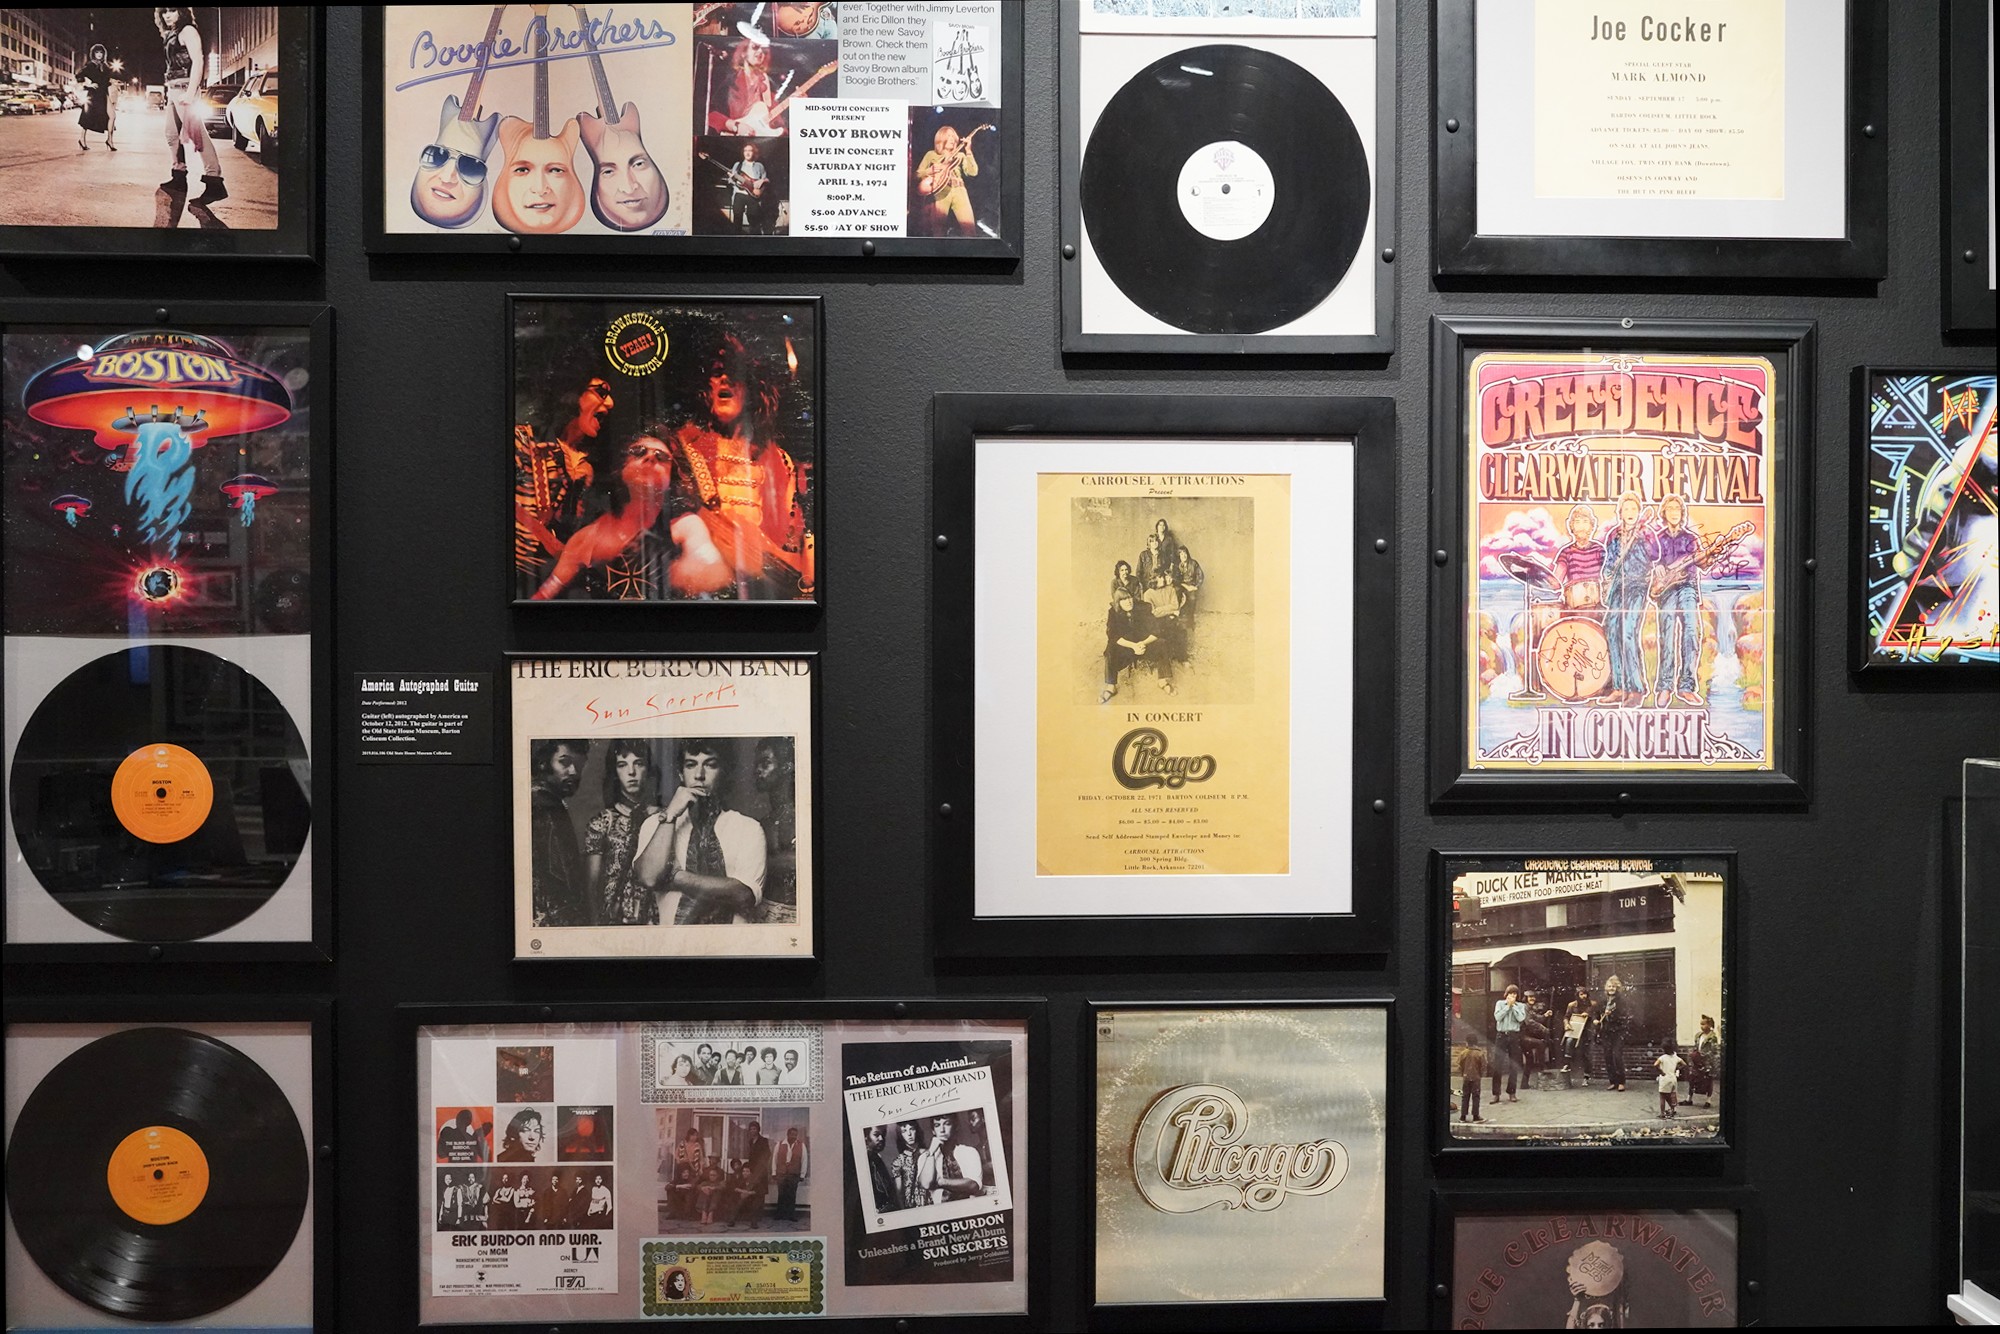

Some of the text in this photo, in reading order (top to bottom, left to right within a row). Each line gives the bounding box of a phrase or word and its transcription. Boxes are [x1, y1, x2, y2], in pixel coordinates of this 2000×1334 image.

[843, 3, 994, 15] ever. Together with Jimmy Leverton
[843, 15, 926, 26] and Eric Dillon they
[898, 28, 924, 39] Savoy
[1591, 15, 1727, 42] Joe Cocker
[410, 9, 676, 81] Boogie Brothers
[843, 65, 870, 76] Savoy
[1611, 72, 1706, 82] MARK ALMOND
[800, 129, 902, 138] SAVOY BROWN
[605, 312, 665, 344] BROWNSVILLE
[620, 333, 655, 358] YEAH!
[96, 350, 232, 382] BOSTON
[621, 356, 663, 377] STATION
[1482, 372, 1763, 448] CREEDENCE
[1942, 386, 1979, 435] DEF
[1081, 476, 1245, 486] CARROUSEL ATTRACTIONS
[1480, 452, 1764, 502] CLEARWATER REVIVAL
[516, 660, 811, 679] THE ERIC BURDON BAND
[361, 679, 479, 694] America Autographed Guitar
[586, 697, 630, 724] Sun
[1127, 713, 1203, 722] IN CONCERT
[1540, 708, 1705, 758] IN CONCERT
[1112, 727, 1217, 790] Chicago
[1477, 876, 1509, 895] DUCK
[1514, 872, 1538, 890] KEE
[1509, 889, 1532, 900] FROZEN
[1534, 889, 1552, 897] FOOD
[1555, 883, 1583, 894] PRODUCE
[1586, 880, 1603, 889] MEAT
[846, 1056, 977, 1086] The Return of an Animal...
[850, 1070, 986, 1102] THE ERIC BURDON BAND
[1134, 1083, 1350, 1214] Chicago
[919, 1214, 1004, 1238] ERIC BURDON
[452, 1234, 602, 1246] ERIC BURDON AND WAR.
[858, 1243, 909, 1259] Unleashes
[917, 1236, 946, 1249] Brand
[948, 1232, 970, 1244] New
[972, 1227, 1006, 1240] Album
[923, 1235, 1008, 1260] SUN SECRETS
[1503, 1214, 1726, 1317] CLEARWATER
[1581, 1252, 1614, 1275] Mardi
